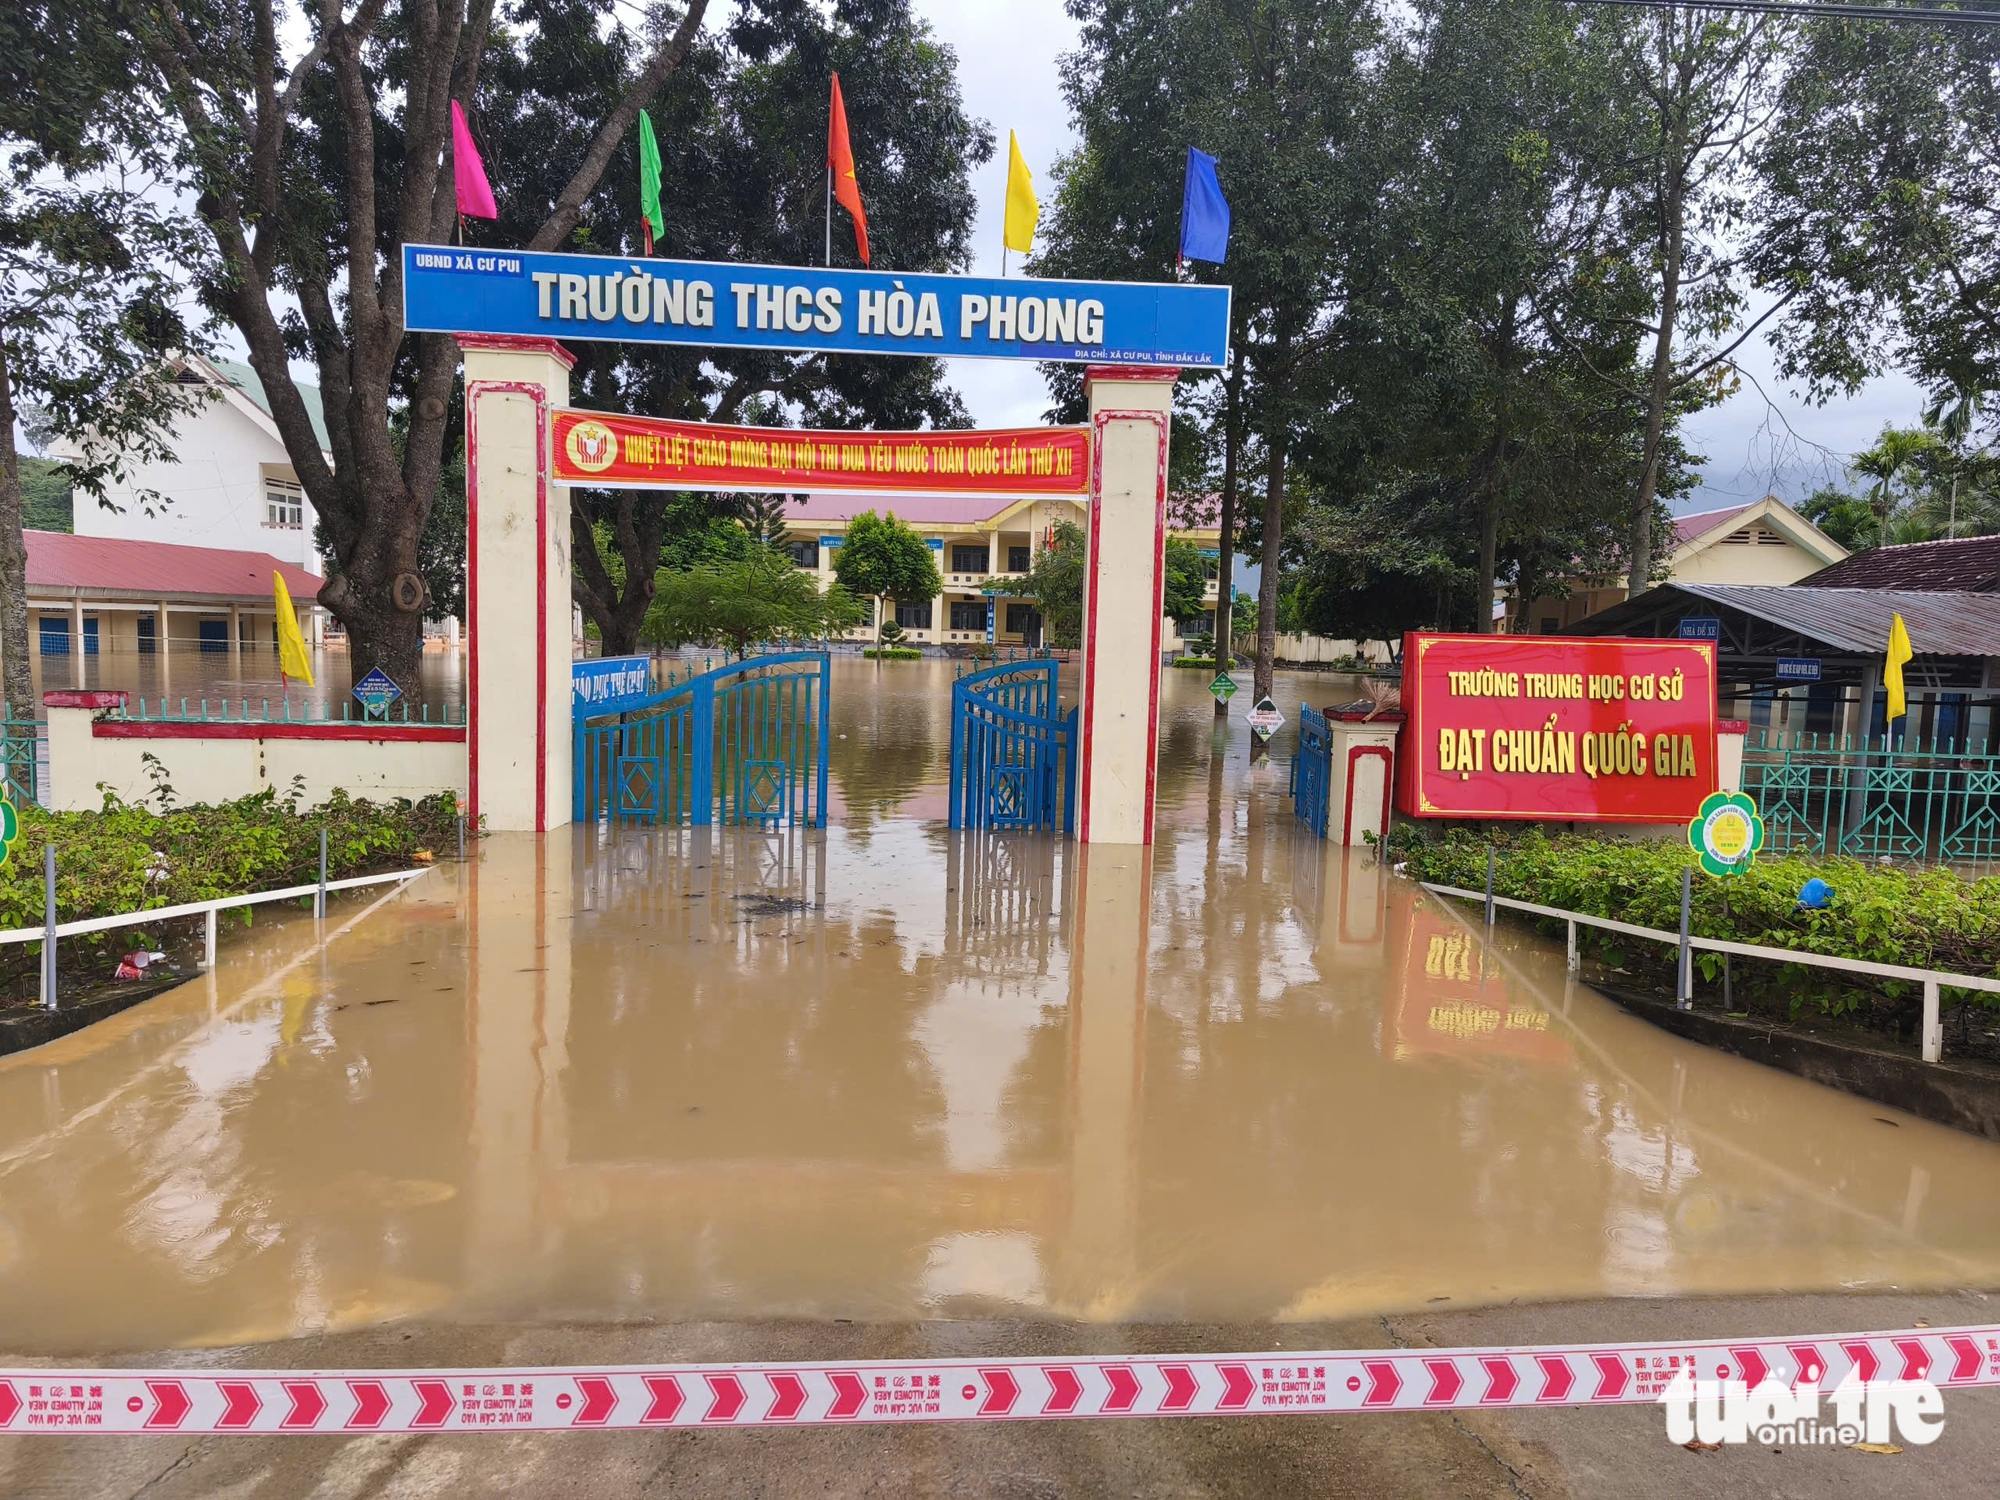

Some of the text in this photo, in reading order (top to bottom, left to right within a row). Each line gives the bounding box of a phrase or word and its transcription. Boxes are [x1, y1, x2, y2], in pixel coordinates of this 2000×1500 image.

[416, 253, 520, 273] UBND XÃ CƯ PUI
[532, 265, 1104, 345] TRƯỜNG THCS HÒA PHONG
[1075, 349, 1090, 359] ĐỊA
[1110, 350, 1121, 360] XÃ
[1123, 351, 1135, 360] CƯ
[1137, 351, 1152, 361] PUI,
[624, 430, 661, 471] NHIỆT
[664, 433, 690, 472] LIỆT
[693, 434, 727, 468] CHÀO
[730, 435, 768, 468] MỪNG
[771, 442, 792, 475] ĐẠI
[795, 438, 816, 476] HỘI
[819, 444, 838, 470] THI
[841, 444, 866, 471] ĐUA
[869, 440, 892, 473] YÊU
[896, 440, 928, 474] NƯỚC
[932, 441, 964, 475] TOÀN
[967, 437, 1000, 478] QUỐC
[1029, 442, 1055, 475] THỨ
[1055, 448, 1073, 476] XI!
[1682, 624, 1696, 636] NHÀ
[1707, 626, 1716, 636] XE
[1448, 665, 1684, 704] TRƯỜNG TRUNG HỌC CƠ SỞ
[1439, 713, 1697, 781] ĐẠT CHUẨN QUỐC GIA
[1636, 1372, 1652, 1382] AREA
[1262, 1381, 1326, 1392] NOT ALLOWED AREA
[874, 1390, 940, 1400] NOT ALLOWED AREA
[1312, 1394, 1326, 1404] KHU
[28, 1400, 102, 1411] NOT ALLOWED AREA
[462, 1399, 533, 1410] NOT ALLOWED AREA
[925, 1403, 939, 1413] KHU
[85, 1414, 102, 1424] KHU
[516, 1412, 532, 1422] KHU
